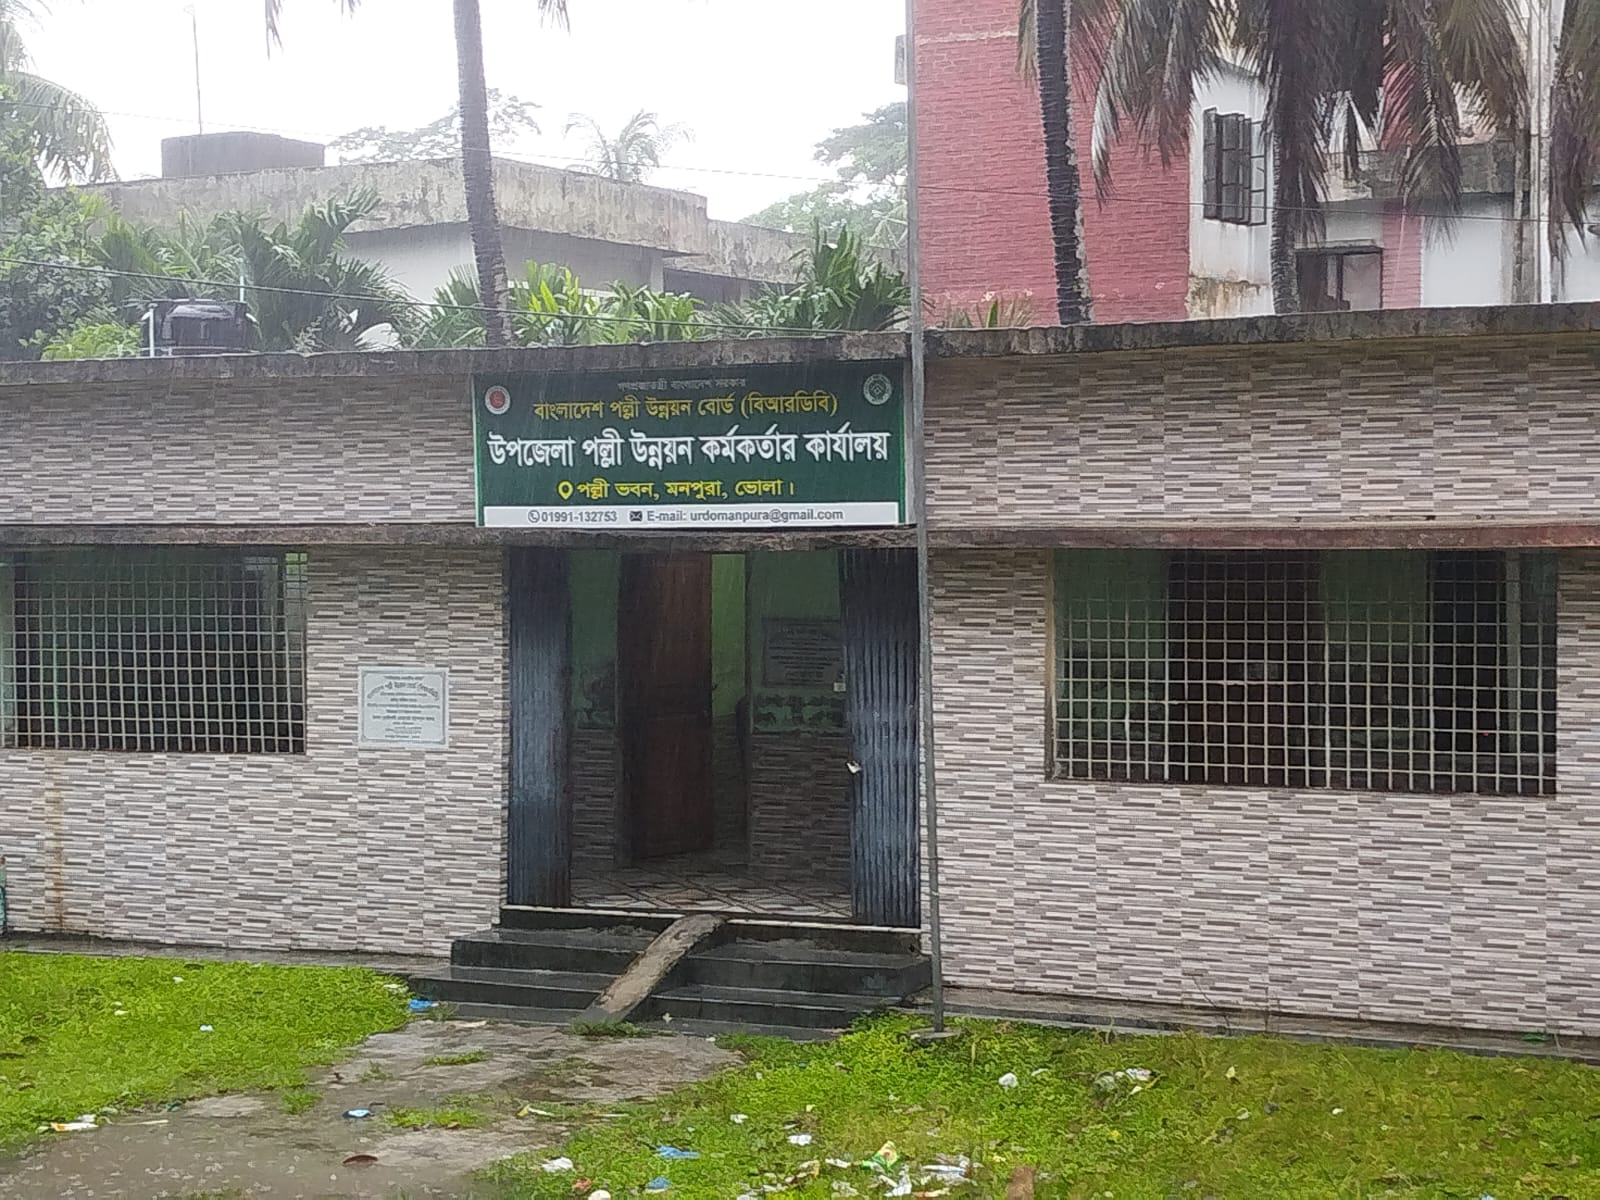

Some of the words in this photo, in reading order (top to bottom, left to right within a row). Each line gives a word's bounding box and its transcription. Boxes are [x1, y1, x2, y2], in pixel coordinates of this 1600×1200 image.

[534, 400, 604, 420] বাংলাদেশ
[609, 394, 641, 420] পল্লী
[645, 395, 693, 420] উন্নয়ন
[697, 391, 735, 416] বোর্ড
[740, 390, 838, 419] (বিআরডিবি)
[487, 431, 576, 467] উপজেলা
[582, 427, 625, 469] পল্লী
[628, 428, 695, 470] উন্নয়ন
[699, 424, 799, 464] কর্মকর্তার
[803, 421, 891, 463] কার্যালয়
[576, 476, 610, 499] পল্লী
[614, 481, 660, 501] ভবন,
[664, 479, 729, 500] মনপুরা,
[541, 510, 618, 523] 01991-132753
[647, 509, 687, 522] E-mail:
[690, 507, 844, 523] urdomanpura@gmail.com
